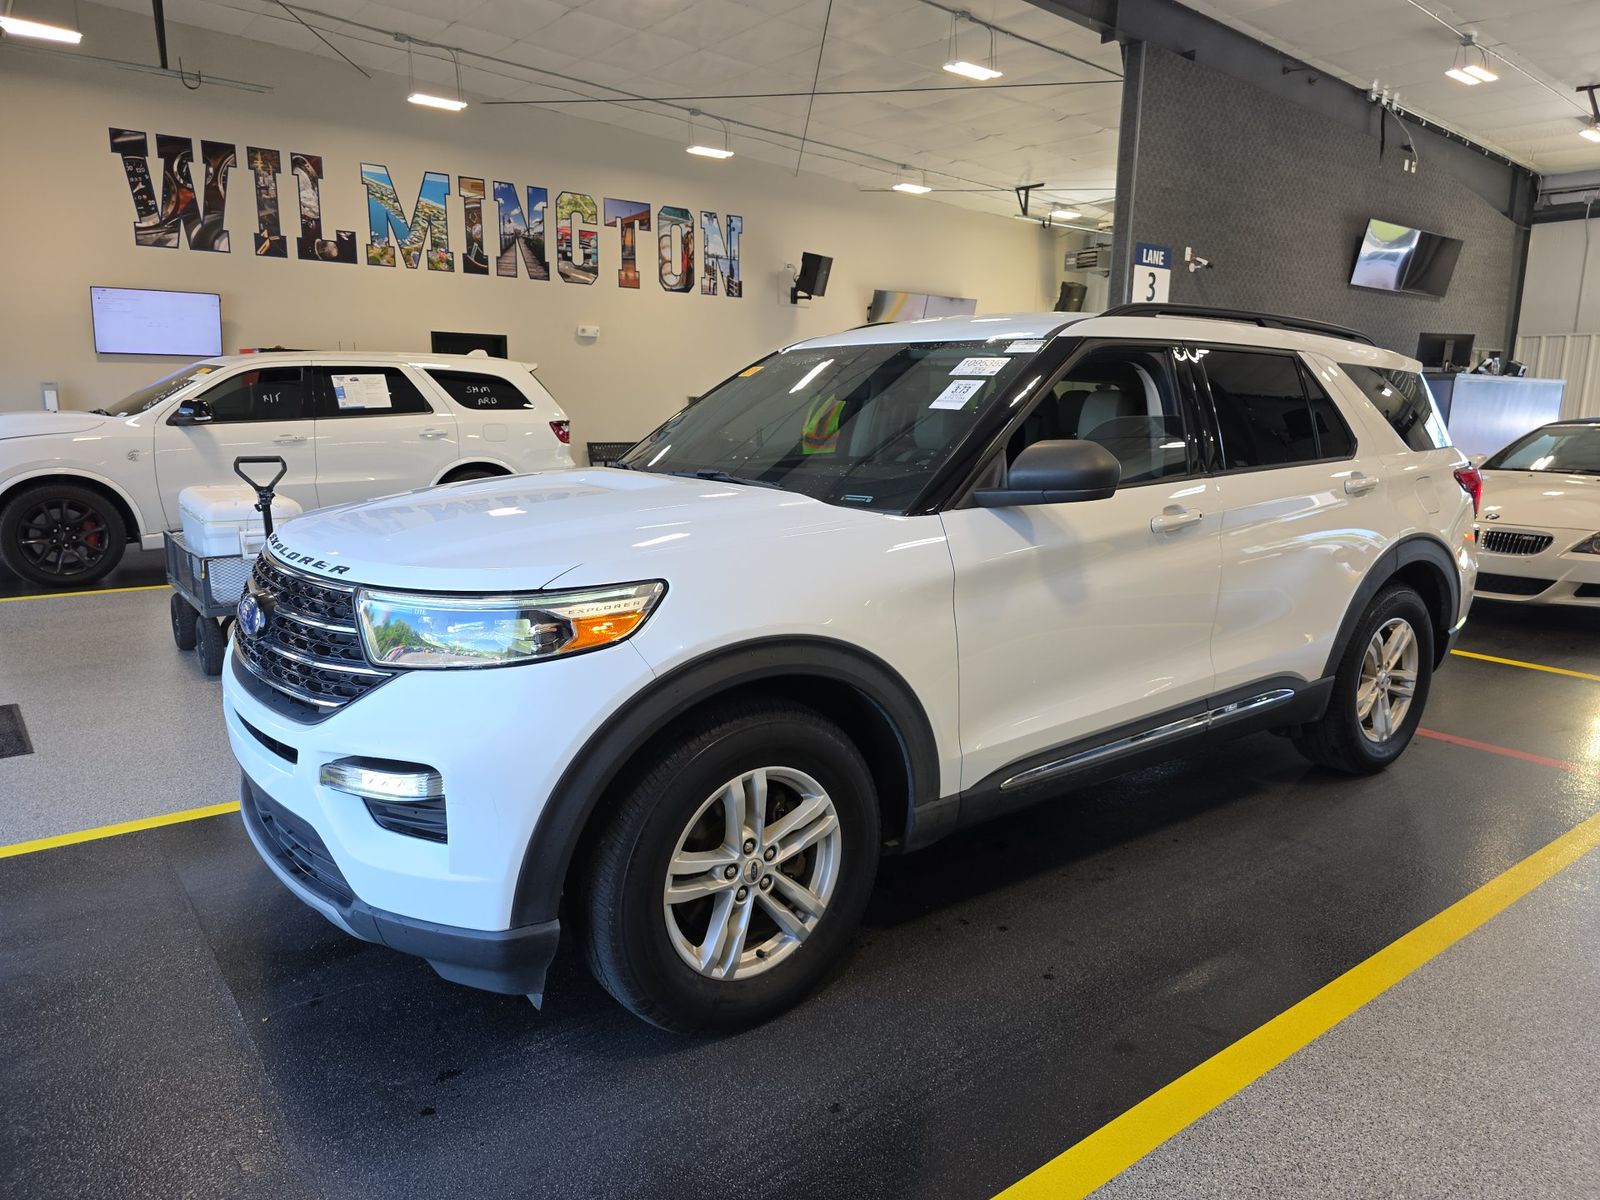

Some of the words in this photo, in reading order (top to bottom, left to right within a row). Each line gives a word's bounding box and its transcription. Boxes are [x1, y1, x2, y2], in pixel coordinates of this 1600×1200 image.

[108, 127, 744, 298] WILMINGTON
[1142, 248, 1165, 266] LANE
[1146, 272, 1156, 301] 3
[269, 533, 351, 575] EXPLORER
[568, 601, 641, 615] EXPLORER
